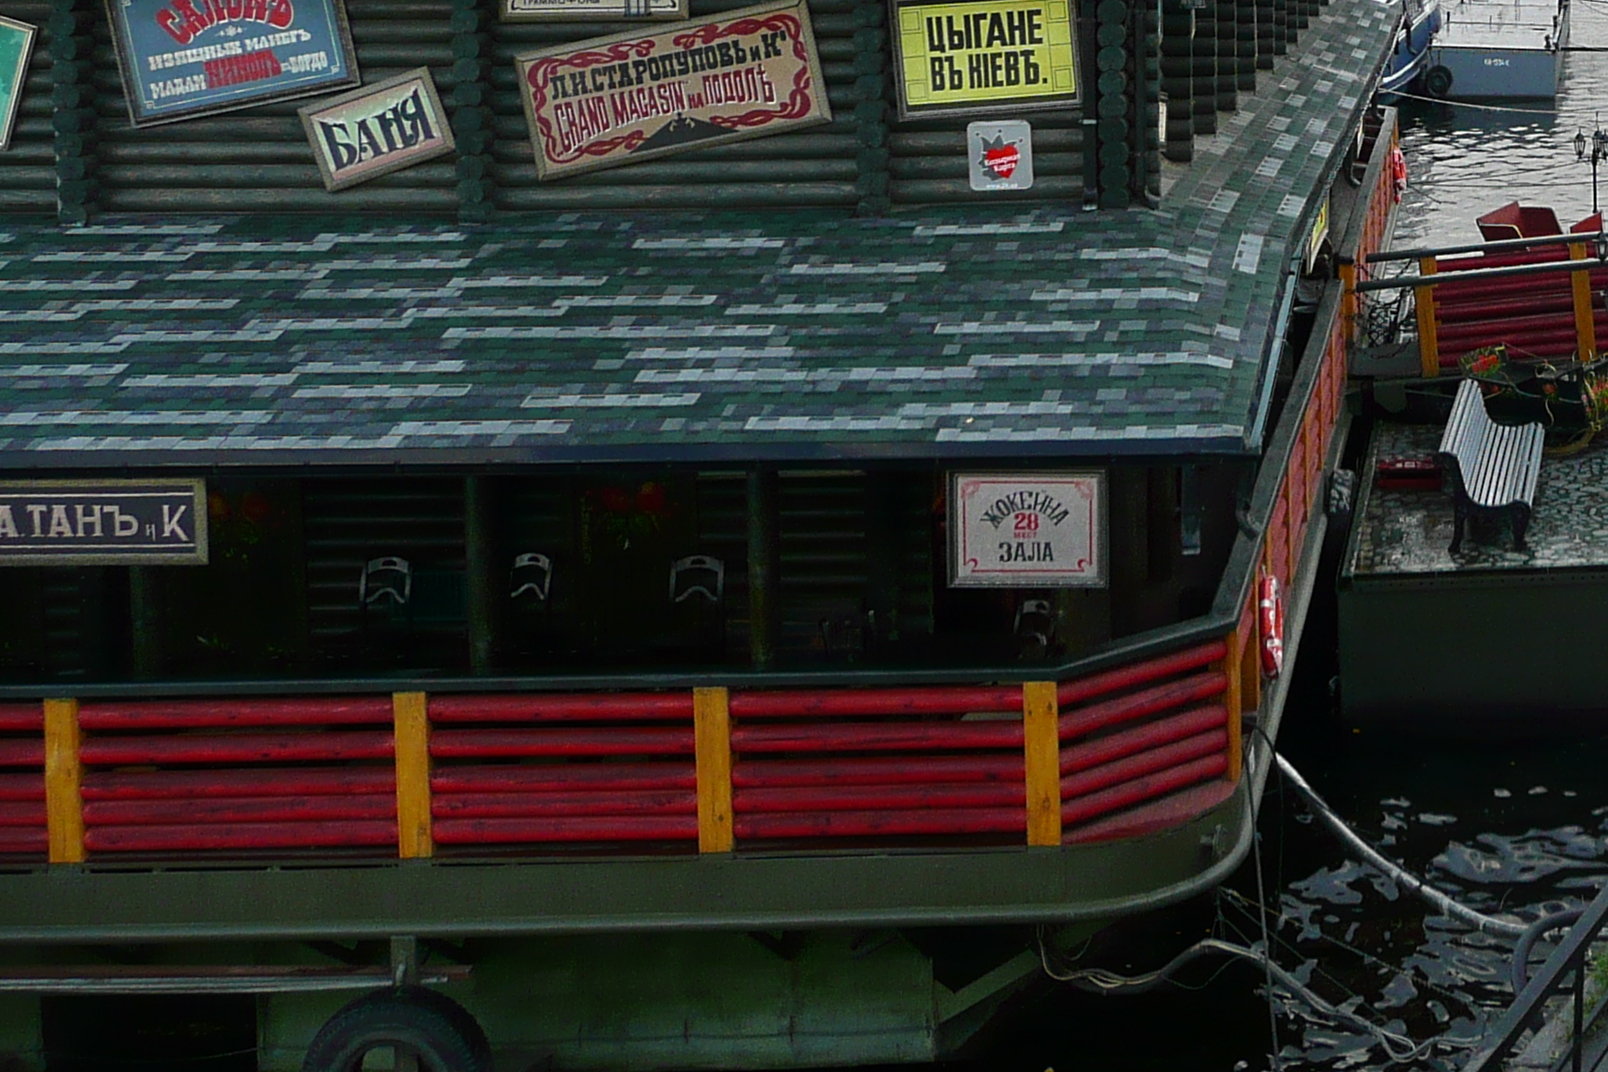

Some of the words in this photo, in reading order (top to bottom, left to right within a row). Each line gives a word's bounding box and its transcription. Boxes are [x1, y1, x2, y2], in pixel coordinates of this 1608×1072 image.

[925, 9, 1044, 54] ЦЫГАНЕ
[929, 56, 963, 92] ВЪ
[319, 87, 436, 172] БАНЯ
[1013, 512, 1040, 531] 28
[998, 541, 1054, 563] ЗАЛА
